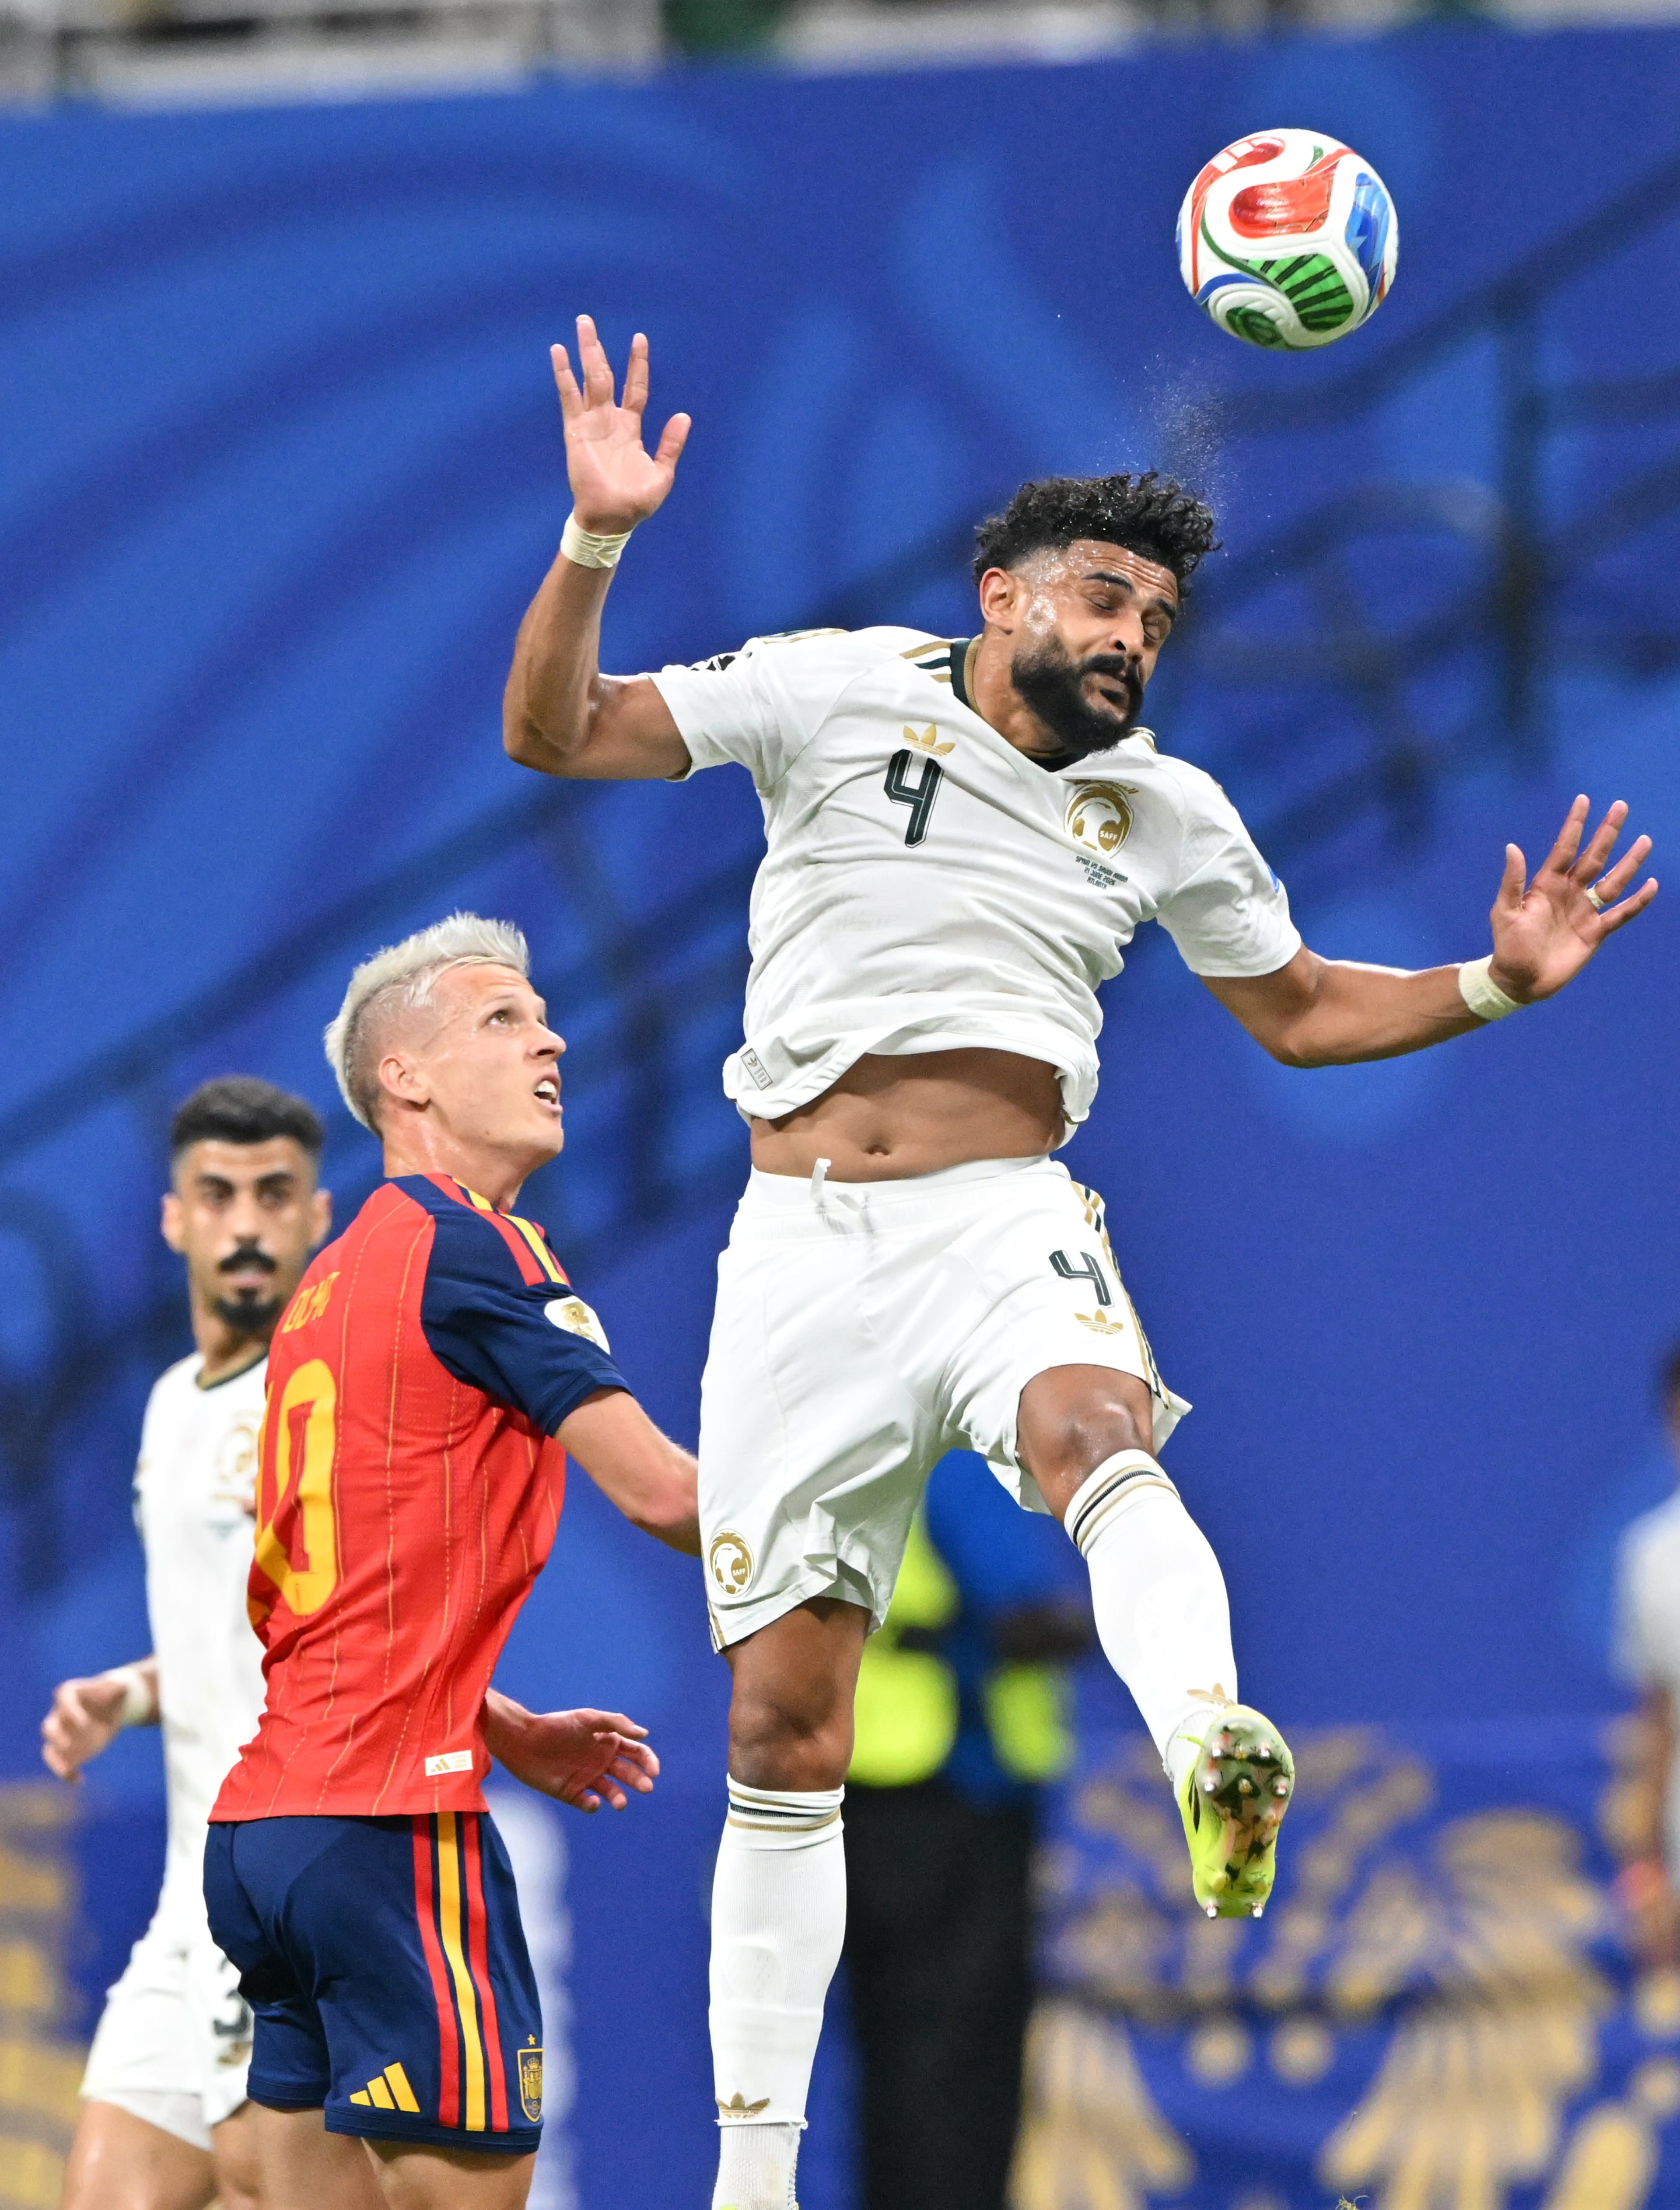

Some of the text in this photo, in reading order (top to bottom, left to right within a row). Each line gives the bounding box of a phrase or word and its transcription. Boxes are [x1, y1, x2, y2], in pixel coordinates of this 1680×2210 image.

[884, 749, 944, 848] 4
[1099, 830, 1118, 841] SAFF
[1075, 856, 1090, 866] SPAIN
[1098, 866, 1113, 876] SAUDI
[1090, 870, 1102, 880] JUNE
[1087, 877, 1107, 890] ATLANTA
[1049, 1250, 1115, 1308] 4
[732, 1567, 746, 1576] SAFF
